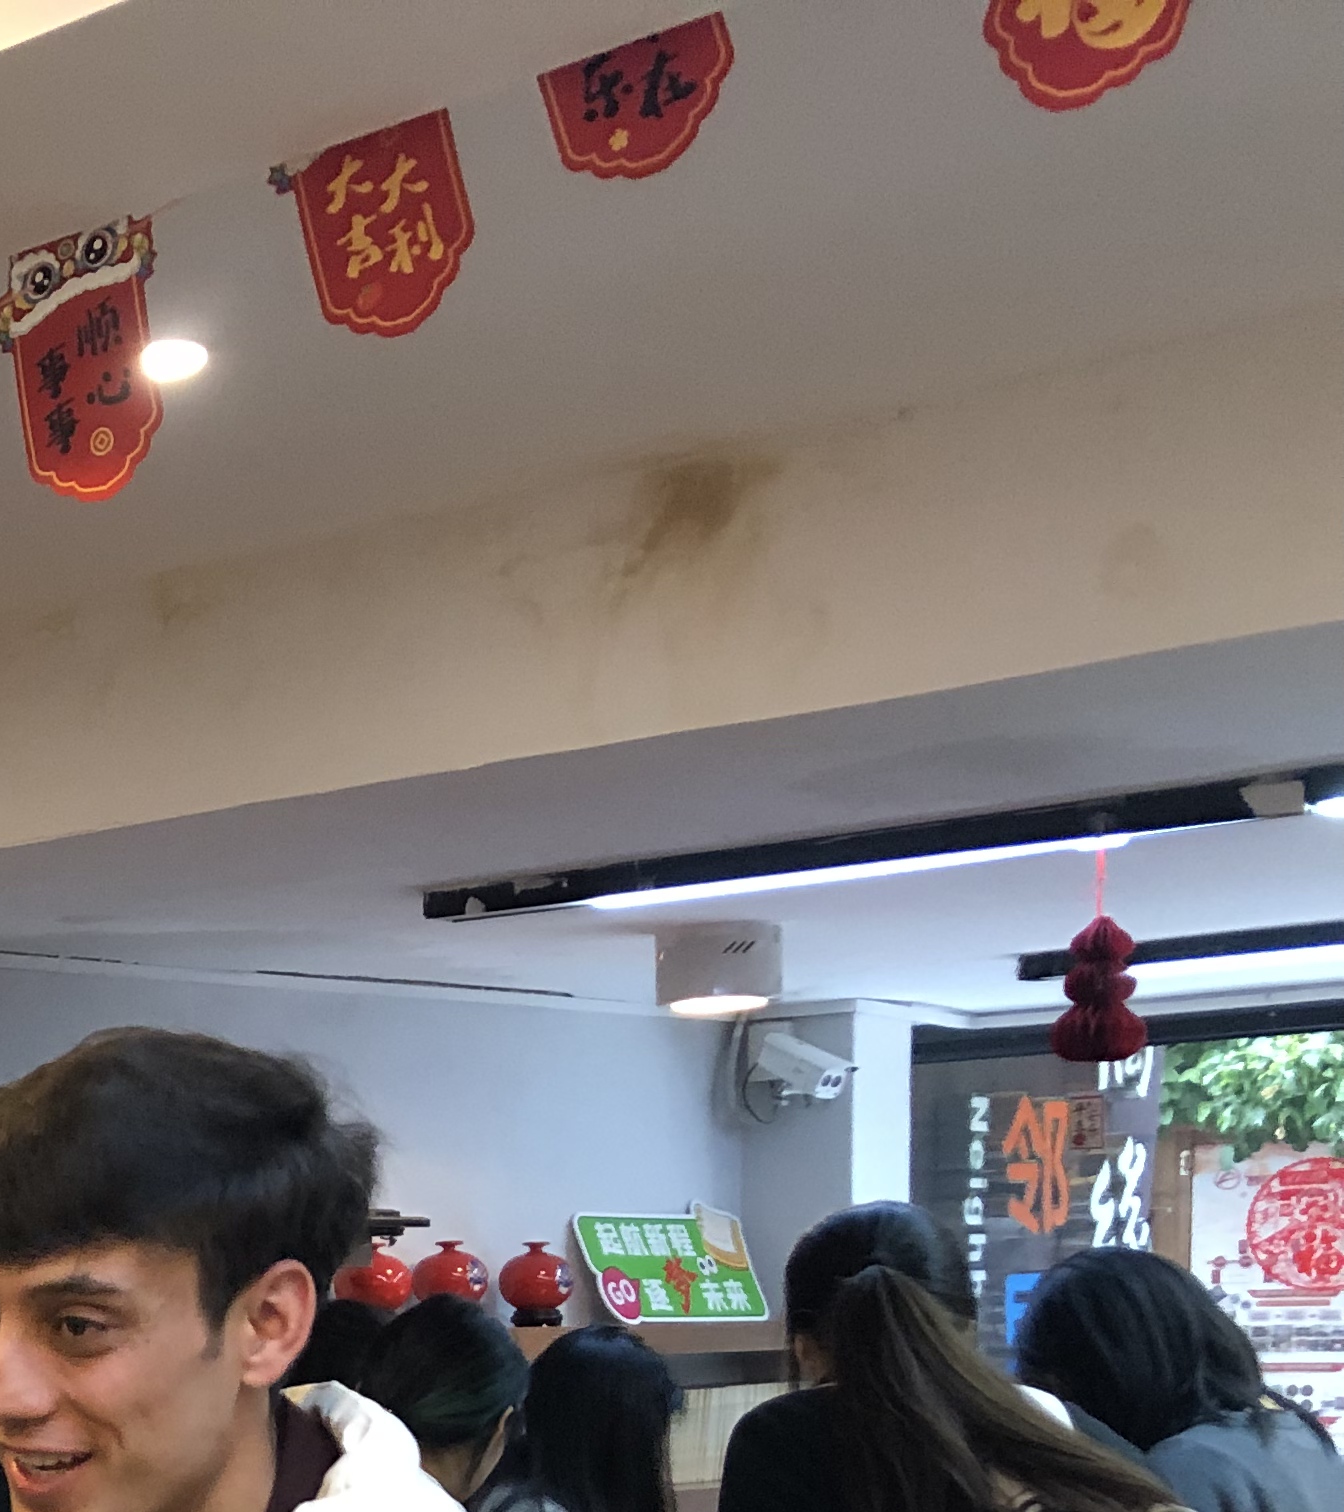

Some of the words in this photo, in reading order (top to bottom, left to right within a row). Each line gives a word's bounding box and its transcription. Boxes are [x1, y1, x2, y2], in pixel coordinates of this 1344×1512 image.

[964, 1096, 991, 1298] Neighb
[607, 1268, 637, 1306] GO
[699, 1278, 752, 1312] 未来
